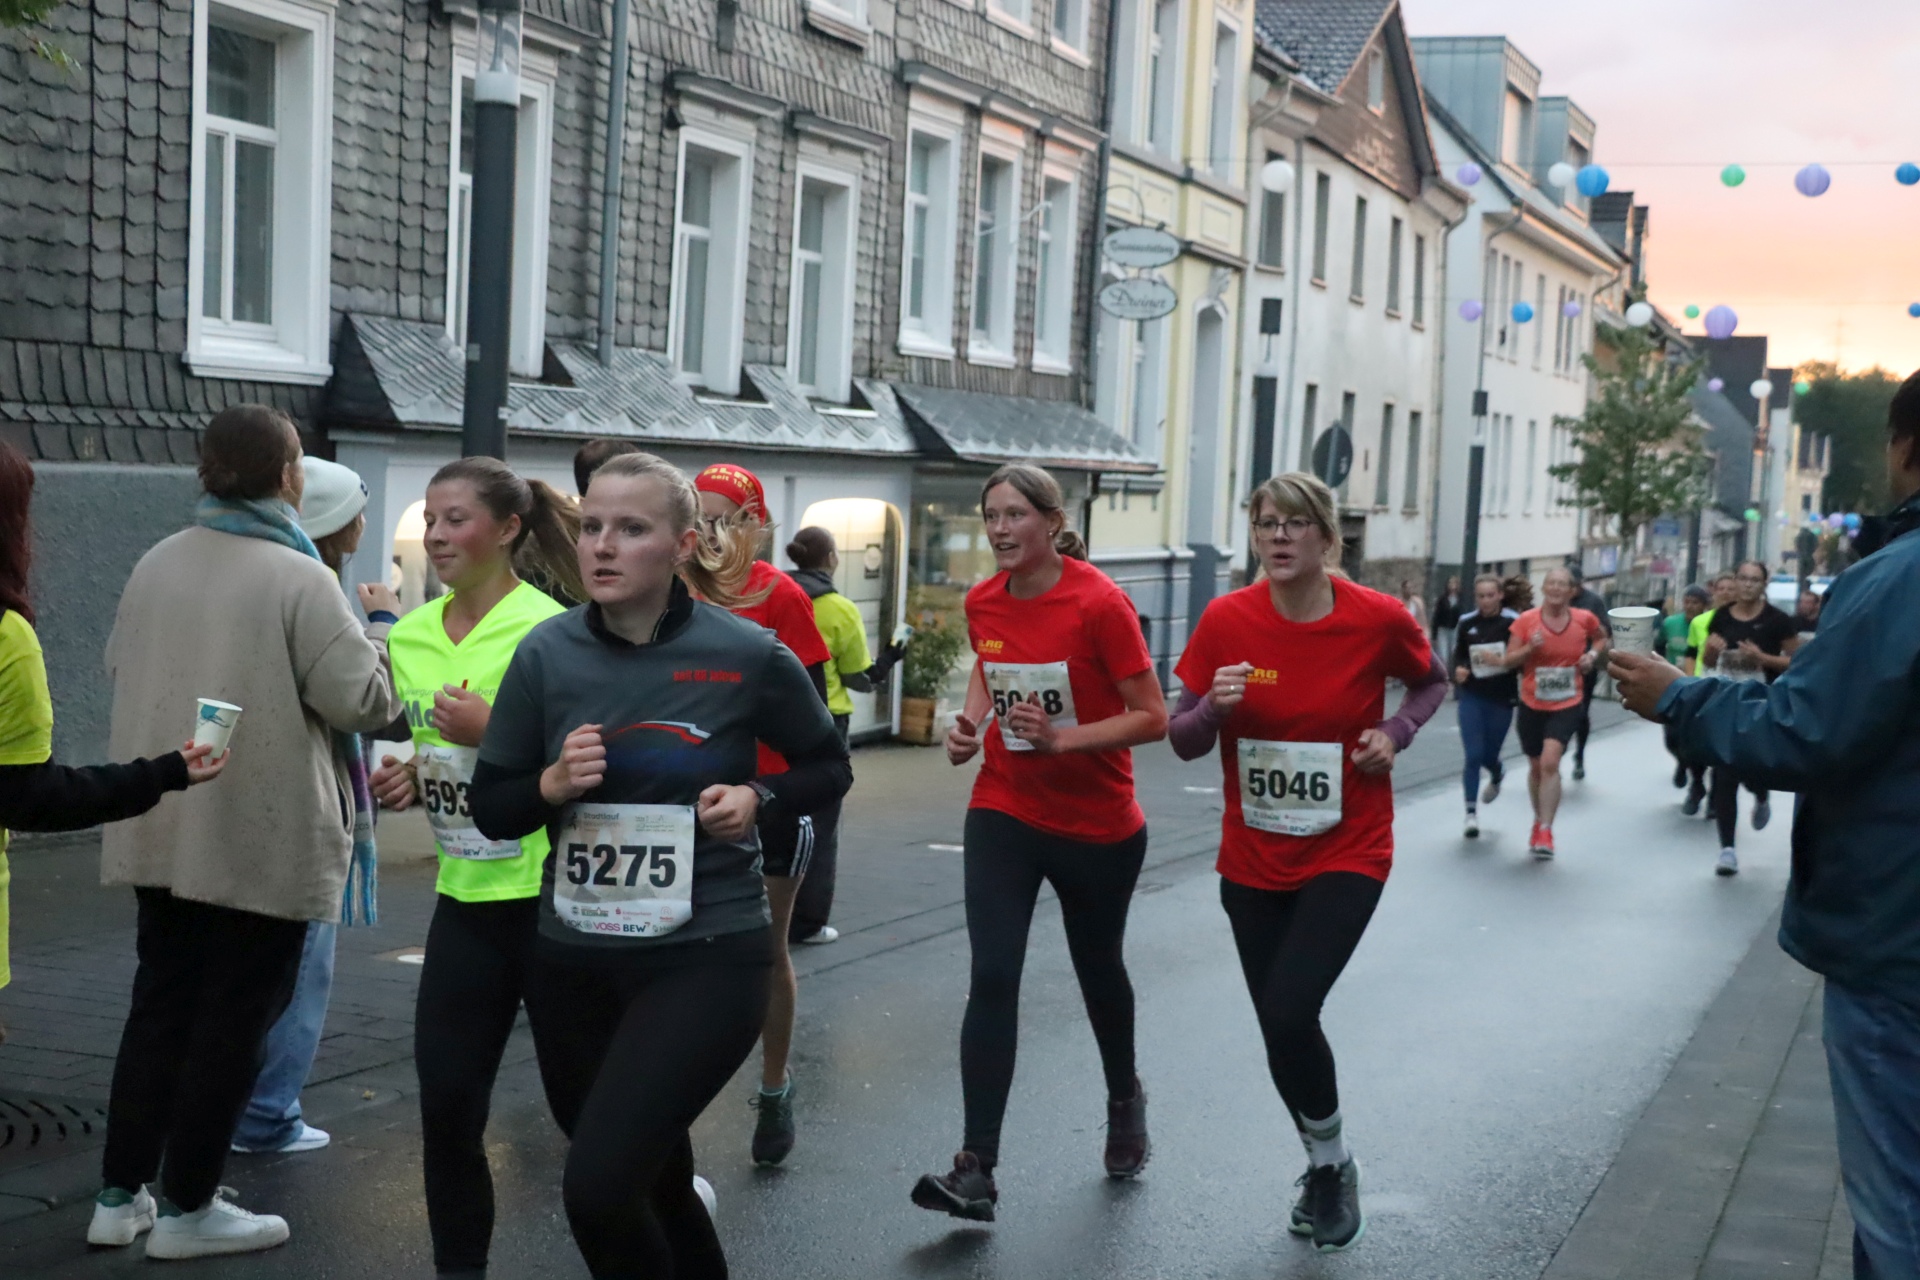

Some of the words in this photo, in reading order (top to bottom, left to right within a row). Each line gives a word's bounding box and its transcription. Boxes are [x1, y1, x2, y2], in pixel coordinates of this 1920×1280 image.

[993, 686, 1064, 717] 508
[423, 778, 473, 818] 593
[1248, 768, 1330, 802] 5046
[566, 843, 676, 888] 5275
[592, 921, 621, 932] VOSS
[622, 923, 646, 933] BEW
